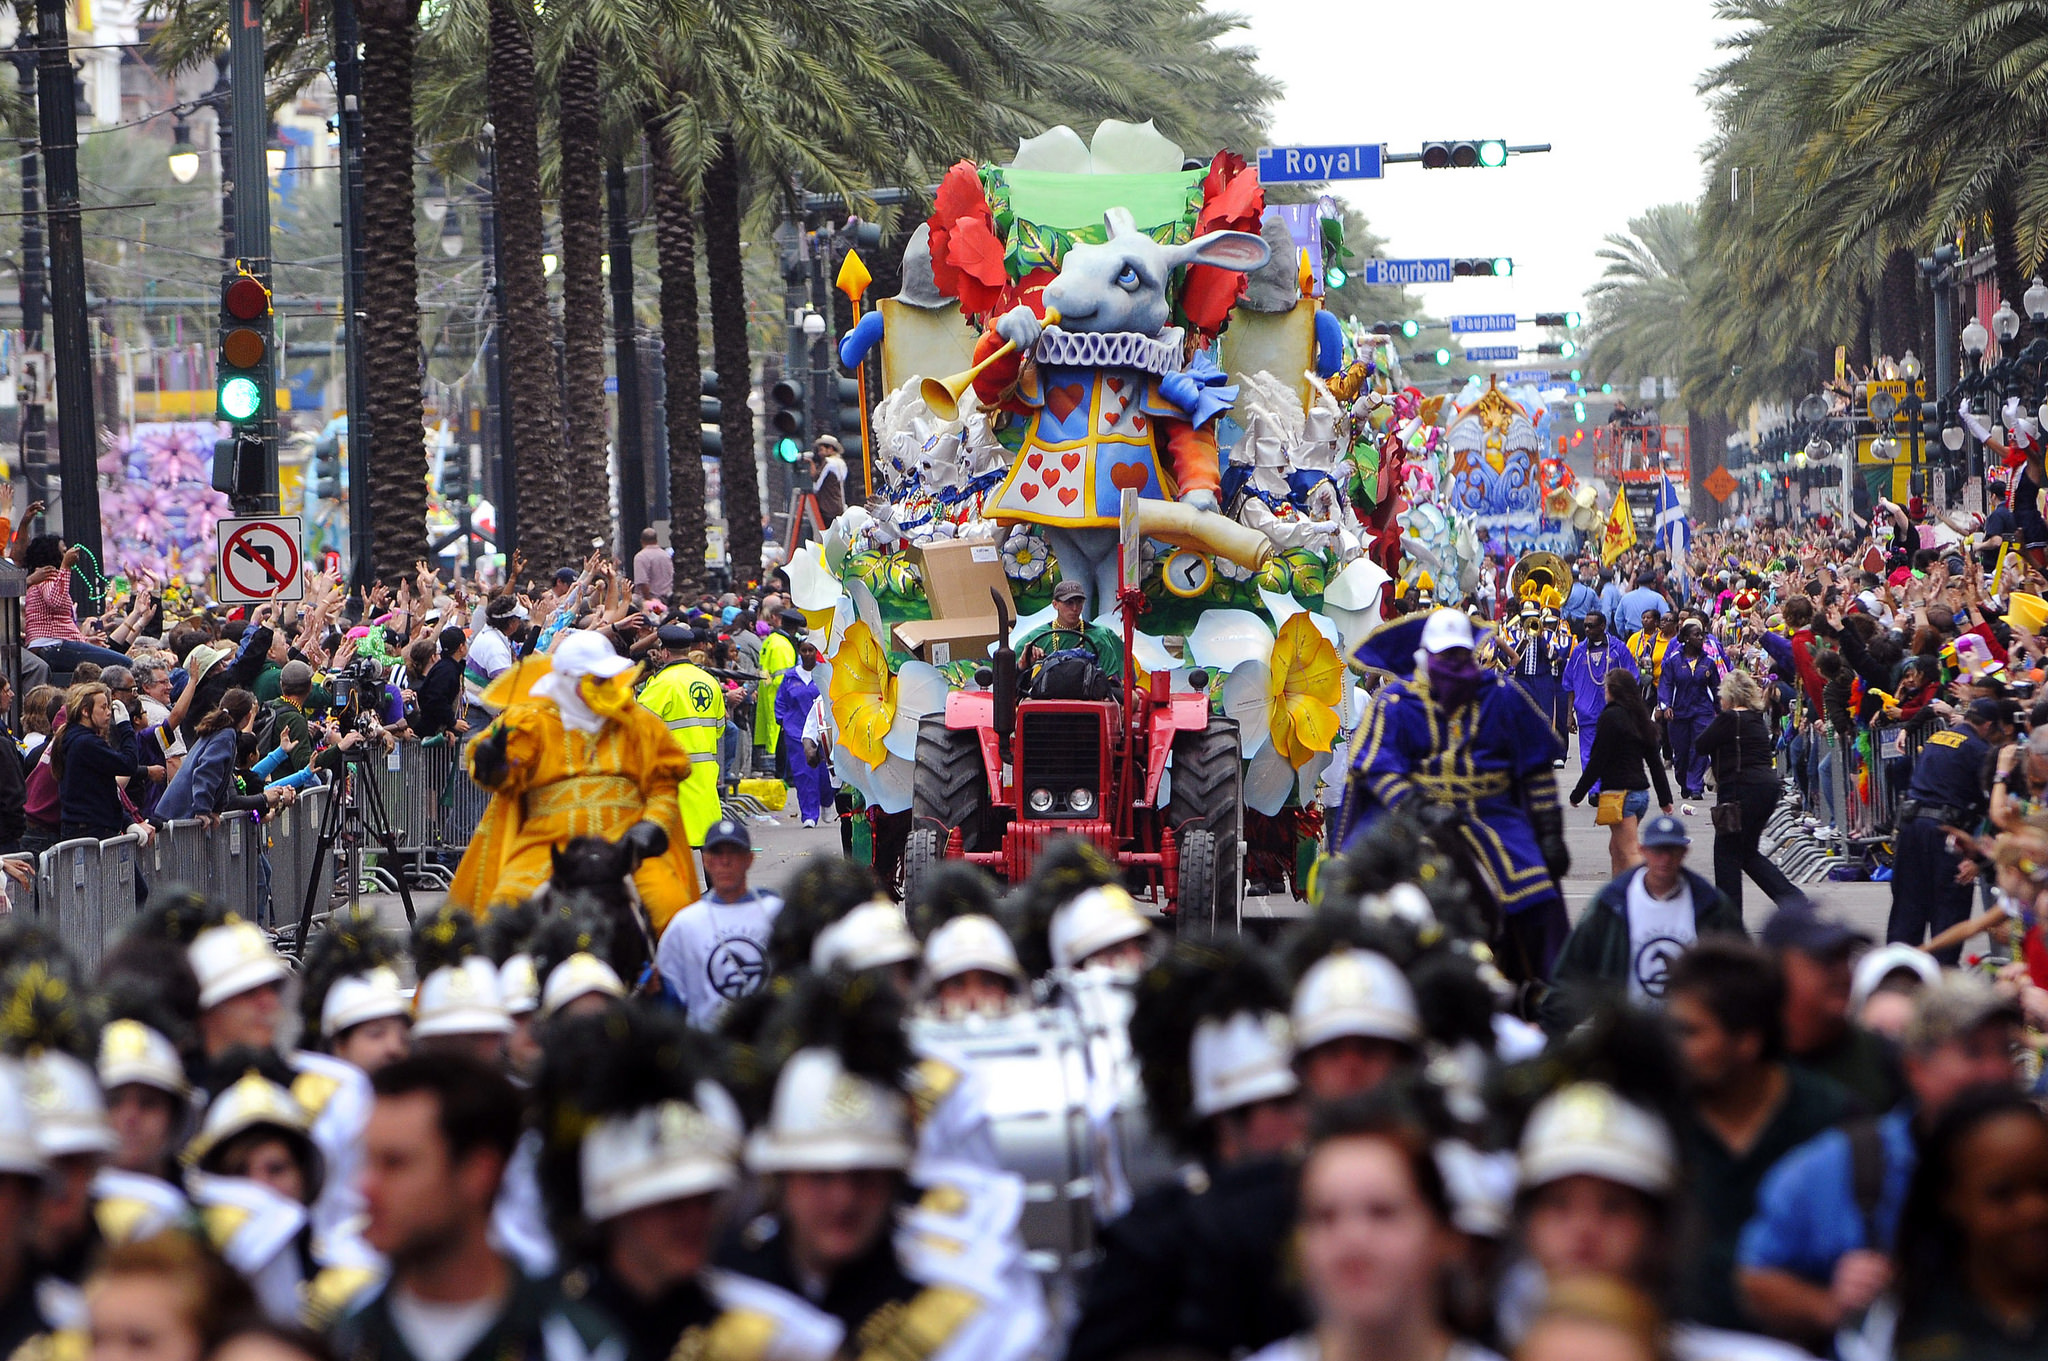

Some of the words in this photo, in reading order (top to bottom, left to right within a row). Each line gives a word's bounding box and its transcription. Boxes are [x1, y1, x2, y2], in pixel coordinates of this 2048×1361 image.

[1285, 147, 1361, 179] Royal
[1377, 260, 1448, 282] Bourbon
[1458, 314, 1515, 332] Dauphine
